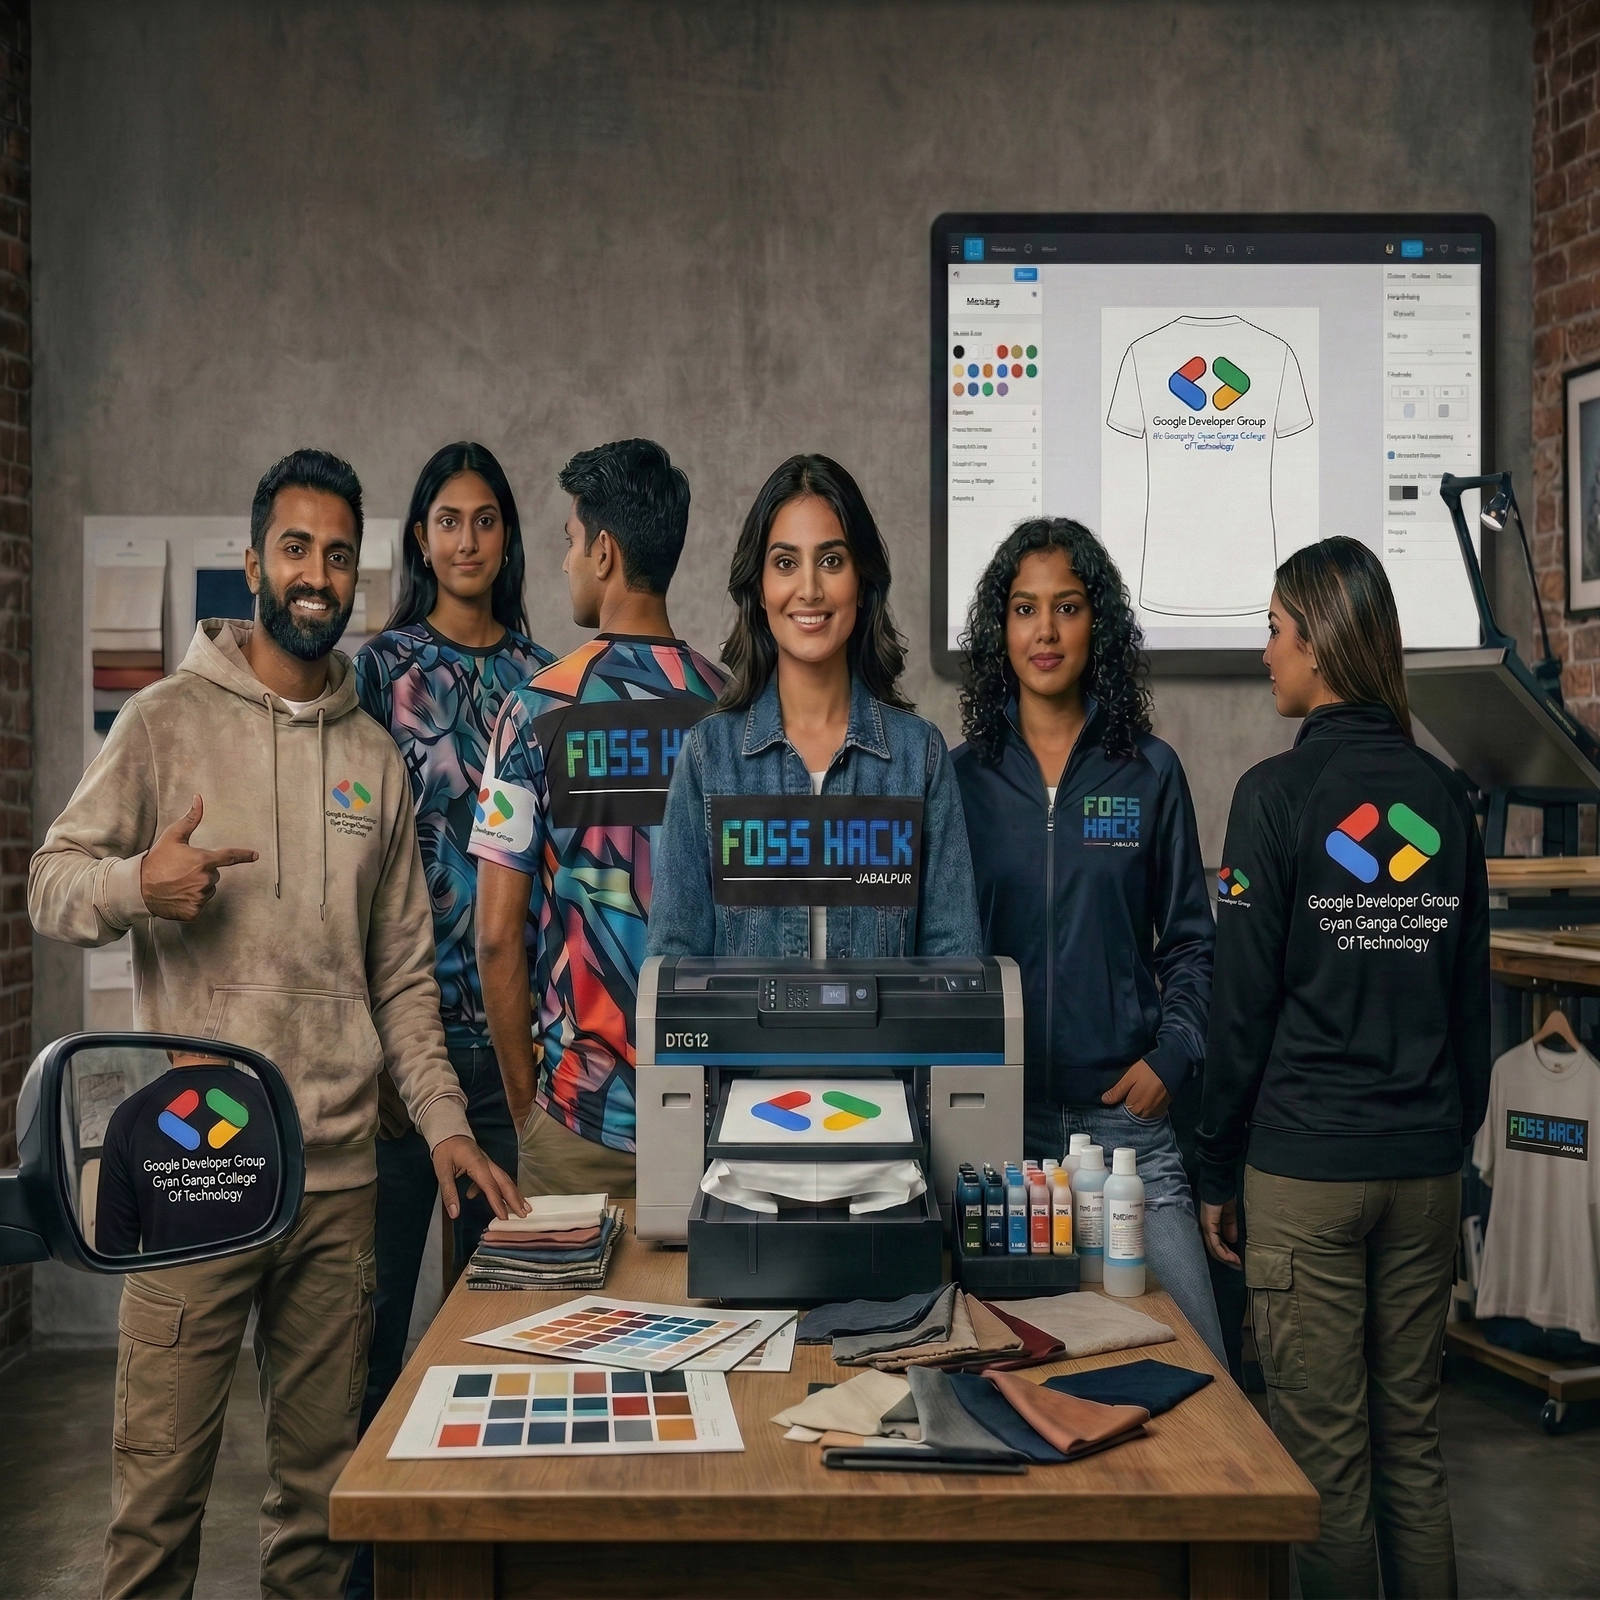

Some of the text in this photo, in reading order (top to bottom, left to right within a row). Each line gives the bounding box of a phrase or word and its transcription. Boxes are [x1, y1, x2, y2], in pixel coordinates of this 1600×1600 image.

[1153, 416, 1266, 428] Google Developer Group
[566, 728, 691, 778] FOSS H
[1083, 796, 1140, 817] FOSS
[1083, 818, 1140, 838] HACK
[722, 819, 913, 866] FOSS HACK
[855, 872, 912, 885] JABALPUR
[1307, 892, 1460, 912] Google Developer Group
[1319, 914, 1448, 934] Gyan Ganga College
[1337, 935, 1430, 953] Of Technology
[665, 1032, 709, 1048] DTG12
[1510, 1116, 1584, 1146] FOSS HACK
[143, 1154, 266, 1174] Google Developer Group
[152, 1172, 257, 1191] Gyan Ganga College
[168, 1188, 243, 1203] Of Technology
